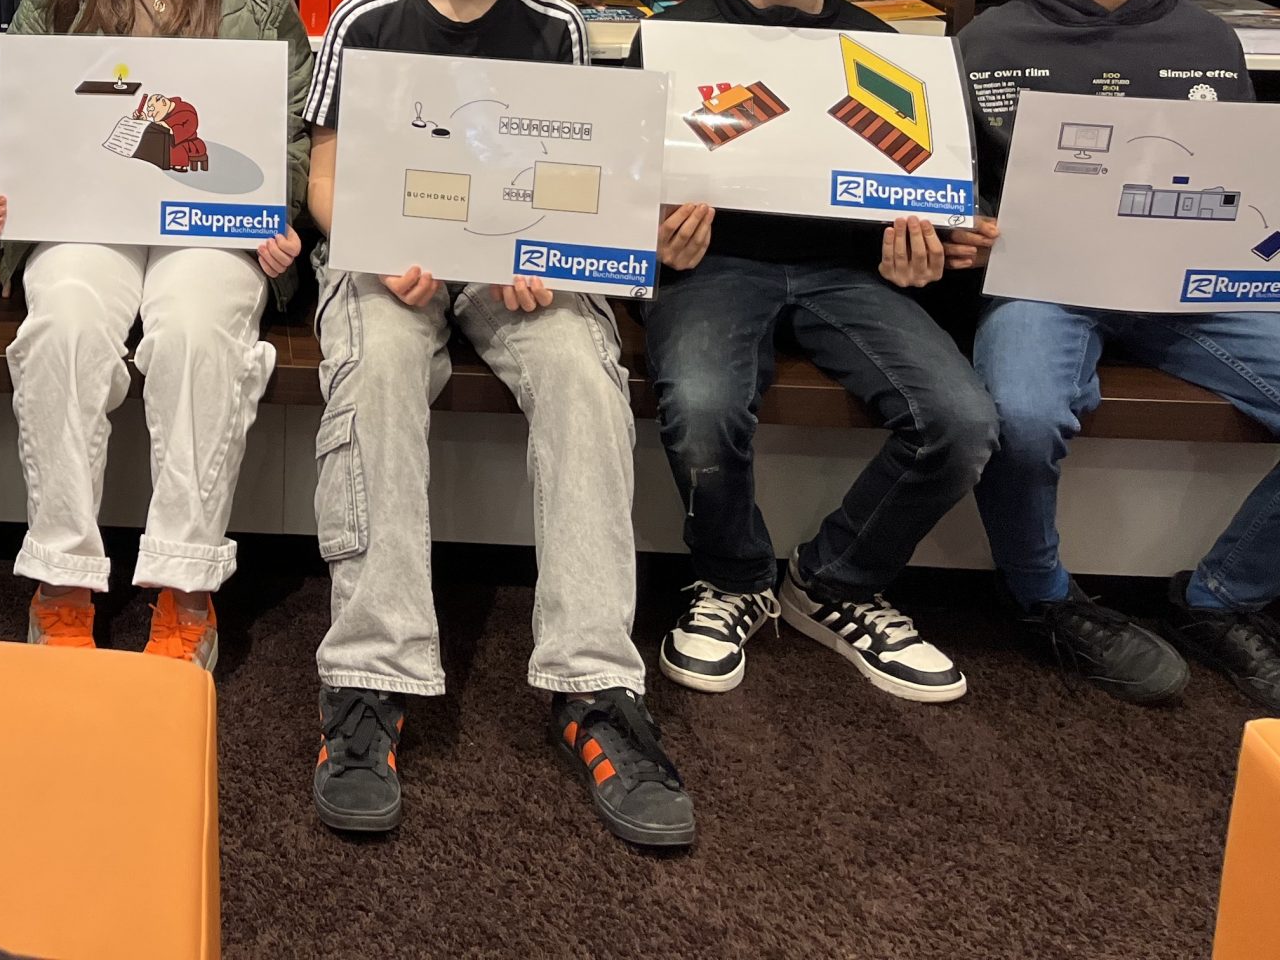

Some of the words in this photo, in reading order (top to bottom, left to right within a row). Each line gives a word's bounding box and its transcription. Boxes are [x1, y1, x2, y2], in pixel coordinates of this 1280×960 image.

[970, 70, 991, 80] Our
[994, 69, 1021, 78] own
[1025, 68, 1050, 76] film
[1159, 69, 1203, 79] Simple
[407, 191, 466, 203] BUCHDRUCK
[866, 182, 966, 206] Rupprecht
[911, 200, 965, 212] Buchhandlung
[192, 210, 280, 232] Rupprecht
[231, 227, 278, 235] Buchhandlung
[549, 251, 648, 277] Rupprecht
[592, 270, 645, 283] Buchhandlung
